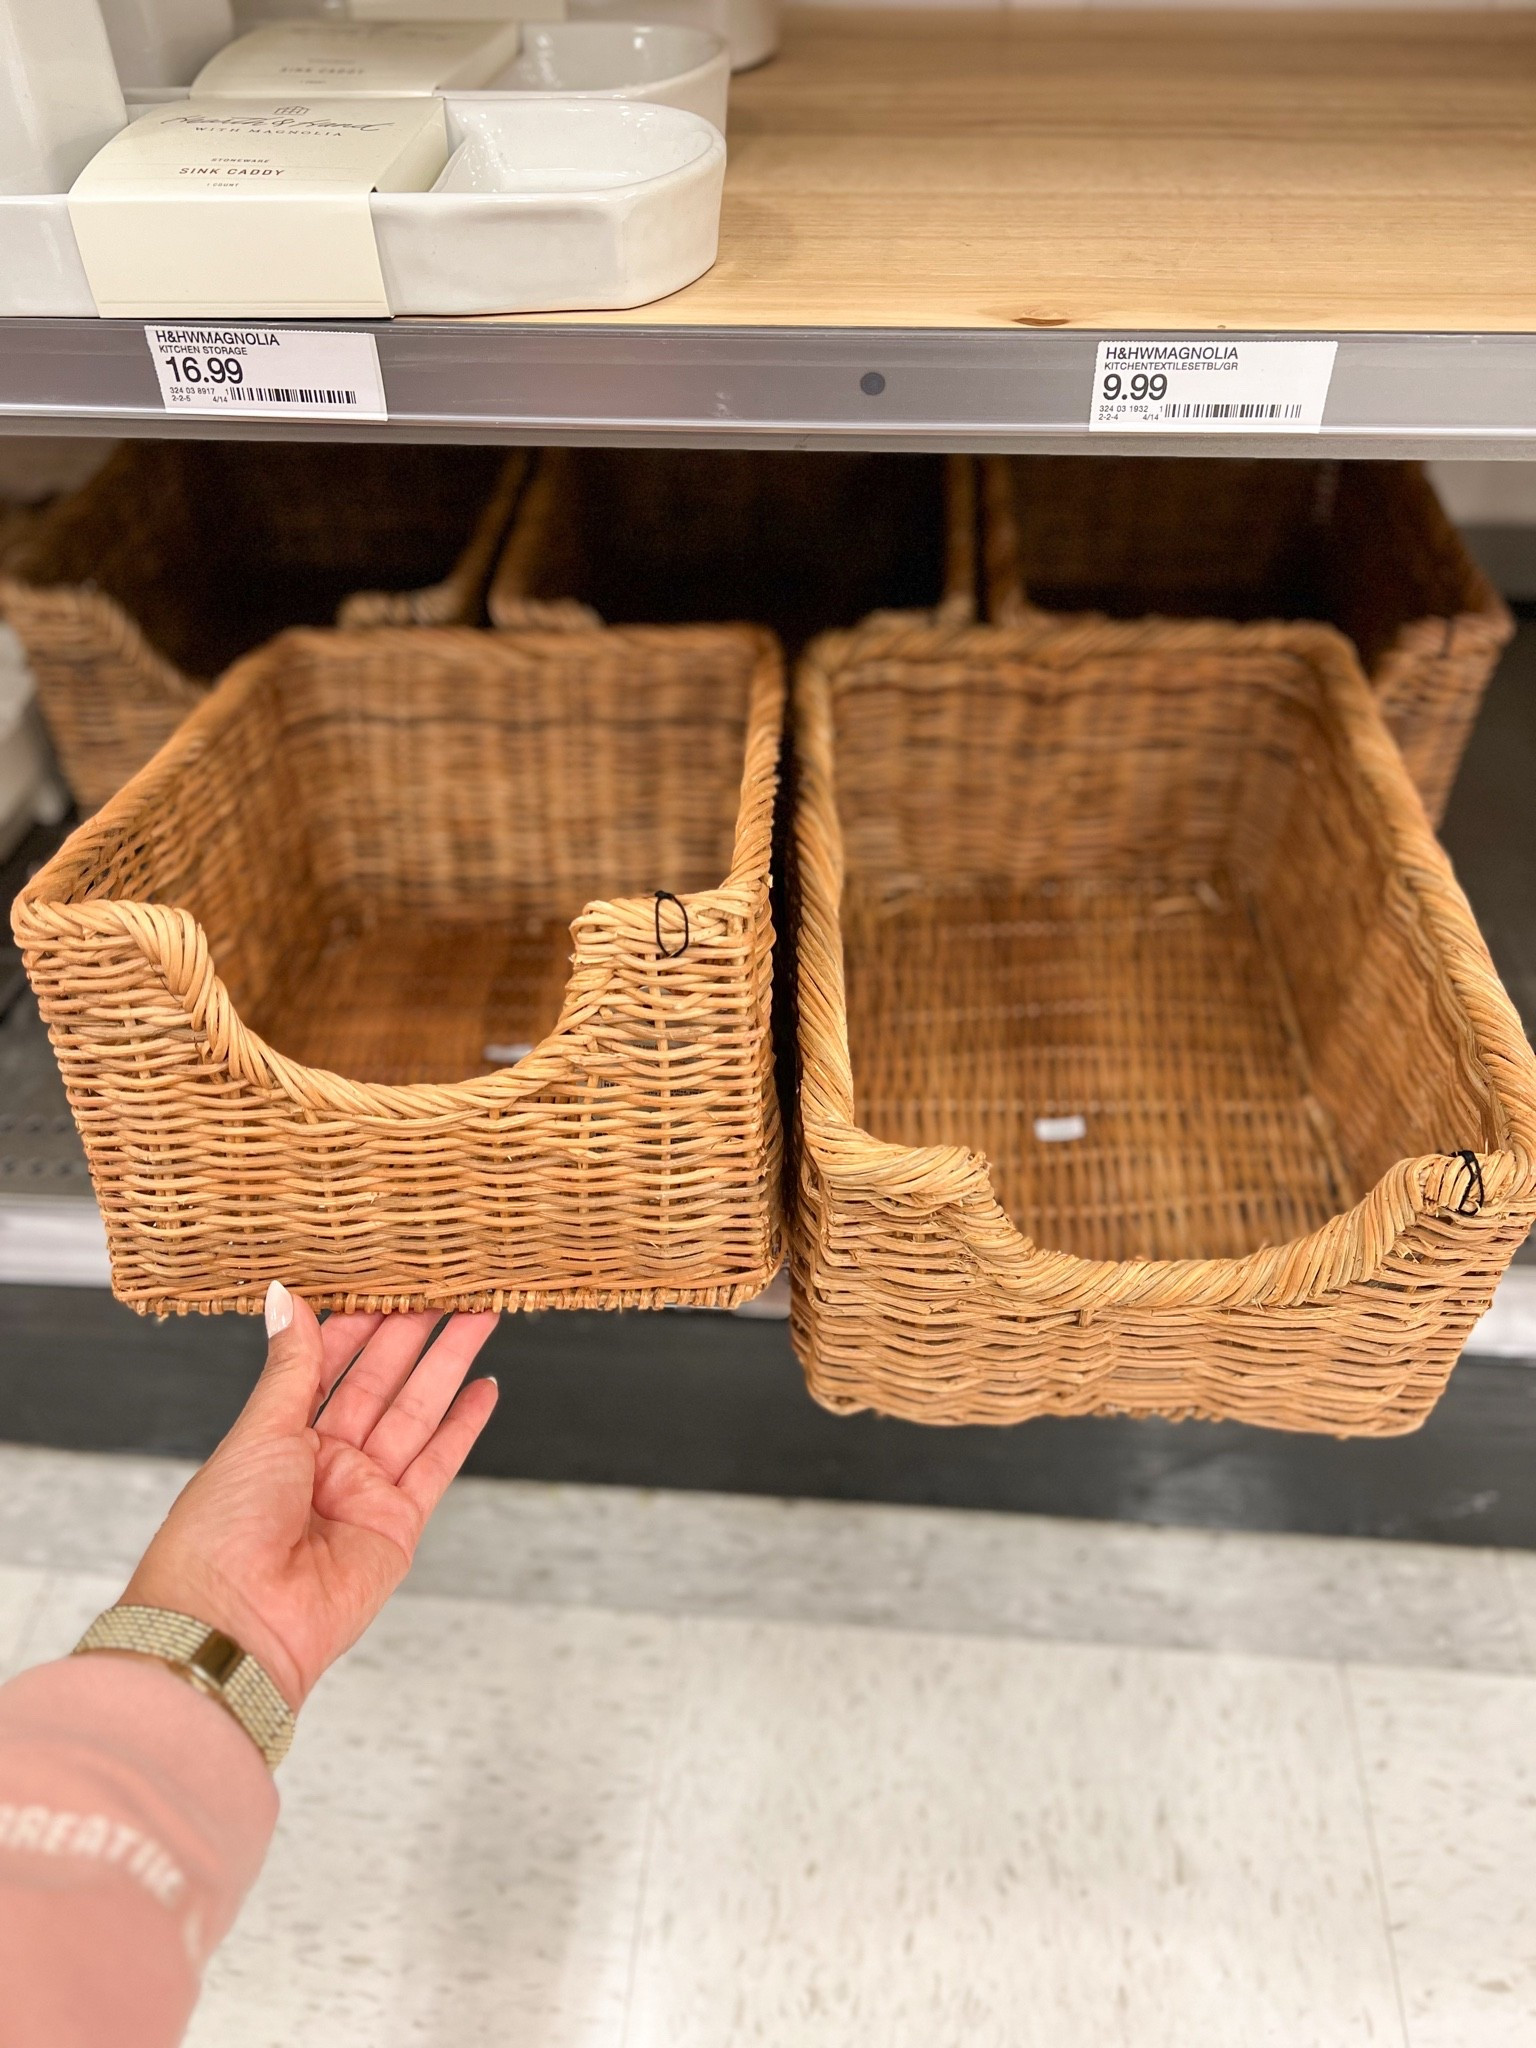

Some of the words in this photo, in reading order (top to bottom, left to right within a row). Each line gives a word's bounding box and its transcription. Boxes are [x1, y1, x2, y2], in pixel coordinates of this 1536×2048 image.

[248, 128, 342, 137] MAGNOLIA
[179, 167, 220, 176] SINK
[227, 168, 285, 177] CADDY
[156, 330, 280, 347] H&HWMAGNOLIA
[159, 344, 201, 355] KITCHEN
[203, 345, 248, 356] STORAGE
[1106, 346, 1239, 360] H&HWMAGNOLIA
[165, 355, 244, 385] 16.99
[1104, 361, 1239, 371] KITCHENTEXTILESETBL/GR
[169, 386, 184, 395] 324
[185, 387, 196, 395] 03
[197, 387, 215, 395] 8917
[1102, 373, 1168, 401] 9.99
[212, 395, 228, 403] 4/14
[1099, 405, 1114, 413] 324
[1116, 405, 1127, 413] 03
[1129, 405, 1149, 413] 1932
[1098, 413, 1119, 421] 2-2-4
[1142, 413, 1159, 421] 4/14
